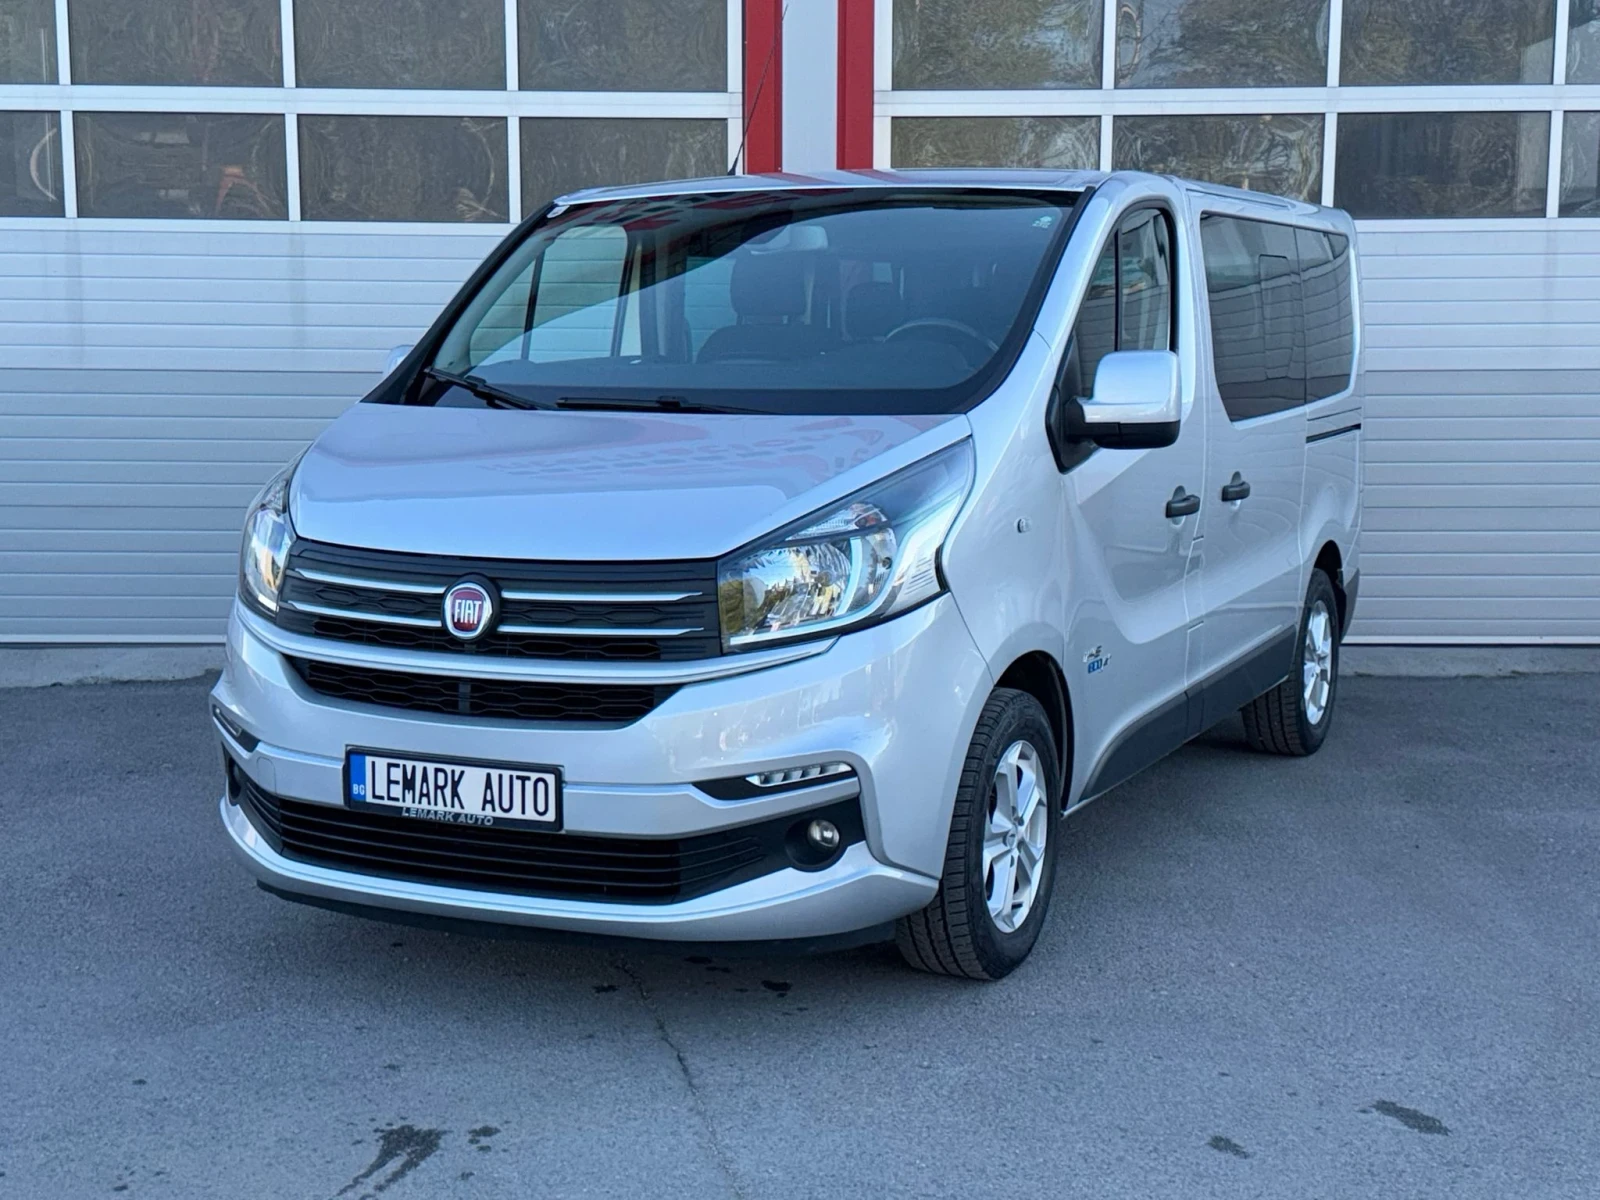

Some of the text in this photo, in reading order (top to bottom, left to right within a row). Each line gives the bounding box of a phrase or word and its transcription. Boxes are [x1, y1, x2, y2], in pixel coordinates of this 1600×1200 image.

[453, 599, 482, 625] FIAT
[352, 783, 365, 796] BG
[371, 760, 549, 817] LEMARK AUTO
[401, 806, 494, 826] LEMARK AUTO
